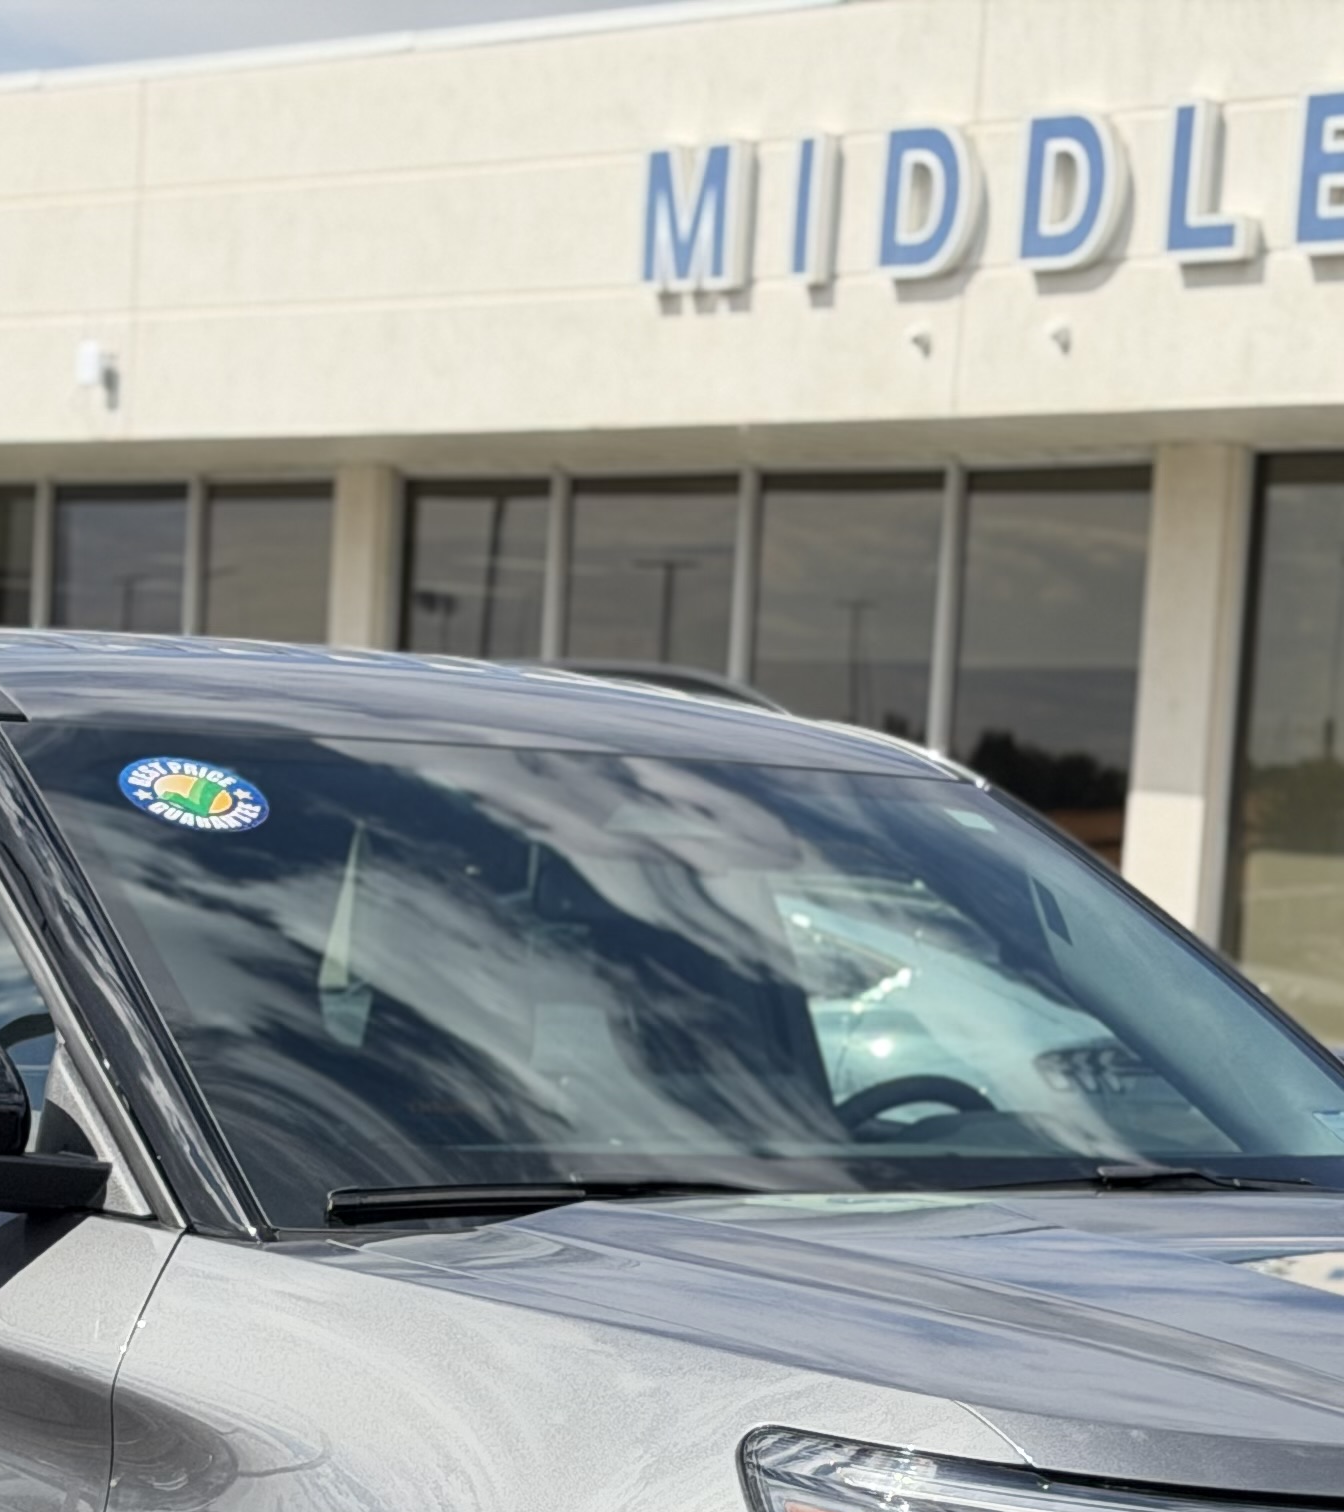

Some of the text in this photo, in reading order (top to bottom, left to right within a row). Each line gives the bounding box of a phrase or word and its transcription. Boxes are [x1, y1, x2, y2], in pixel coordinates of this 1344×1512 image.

[127, 761, 237, 788] BEST PRICE
[147, 801, 262, 830] GUARANTEE
